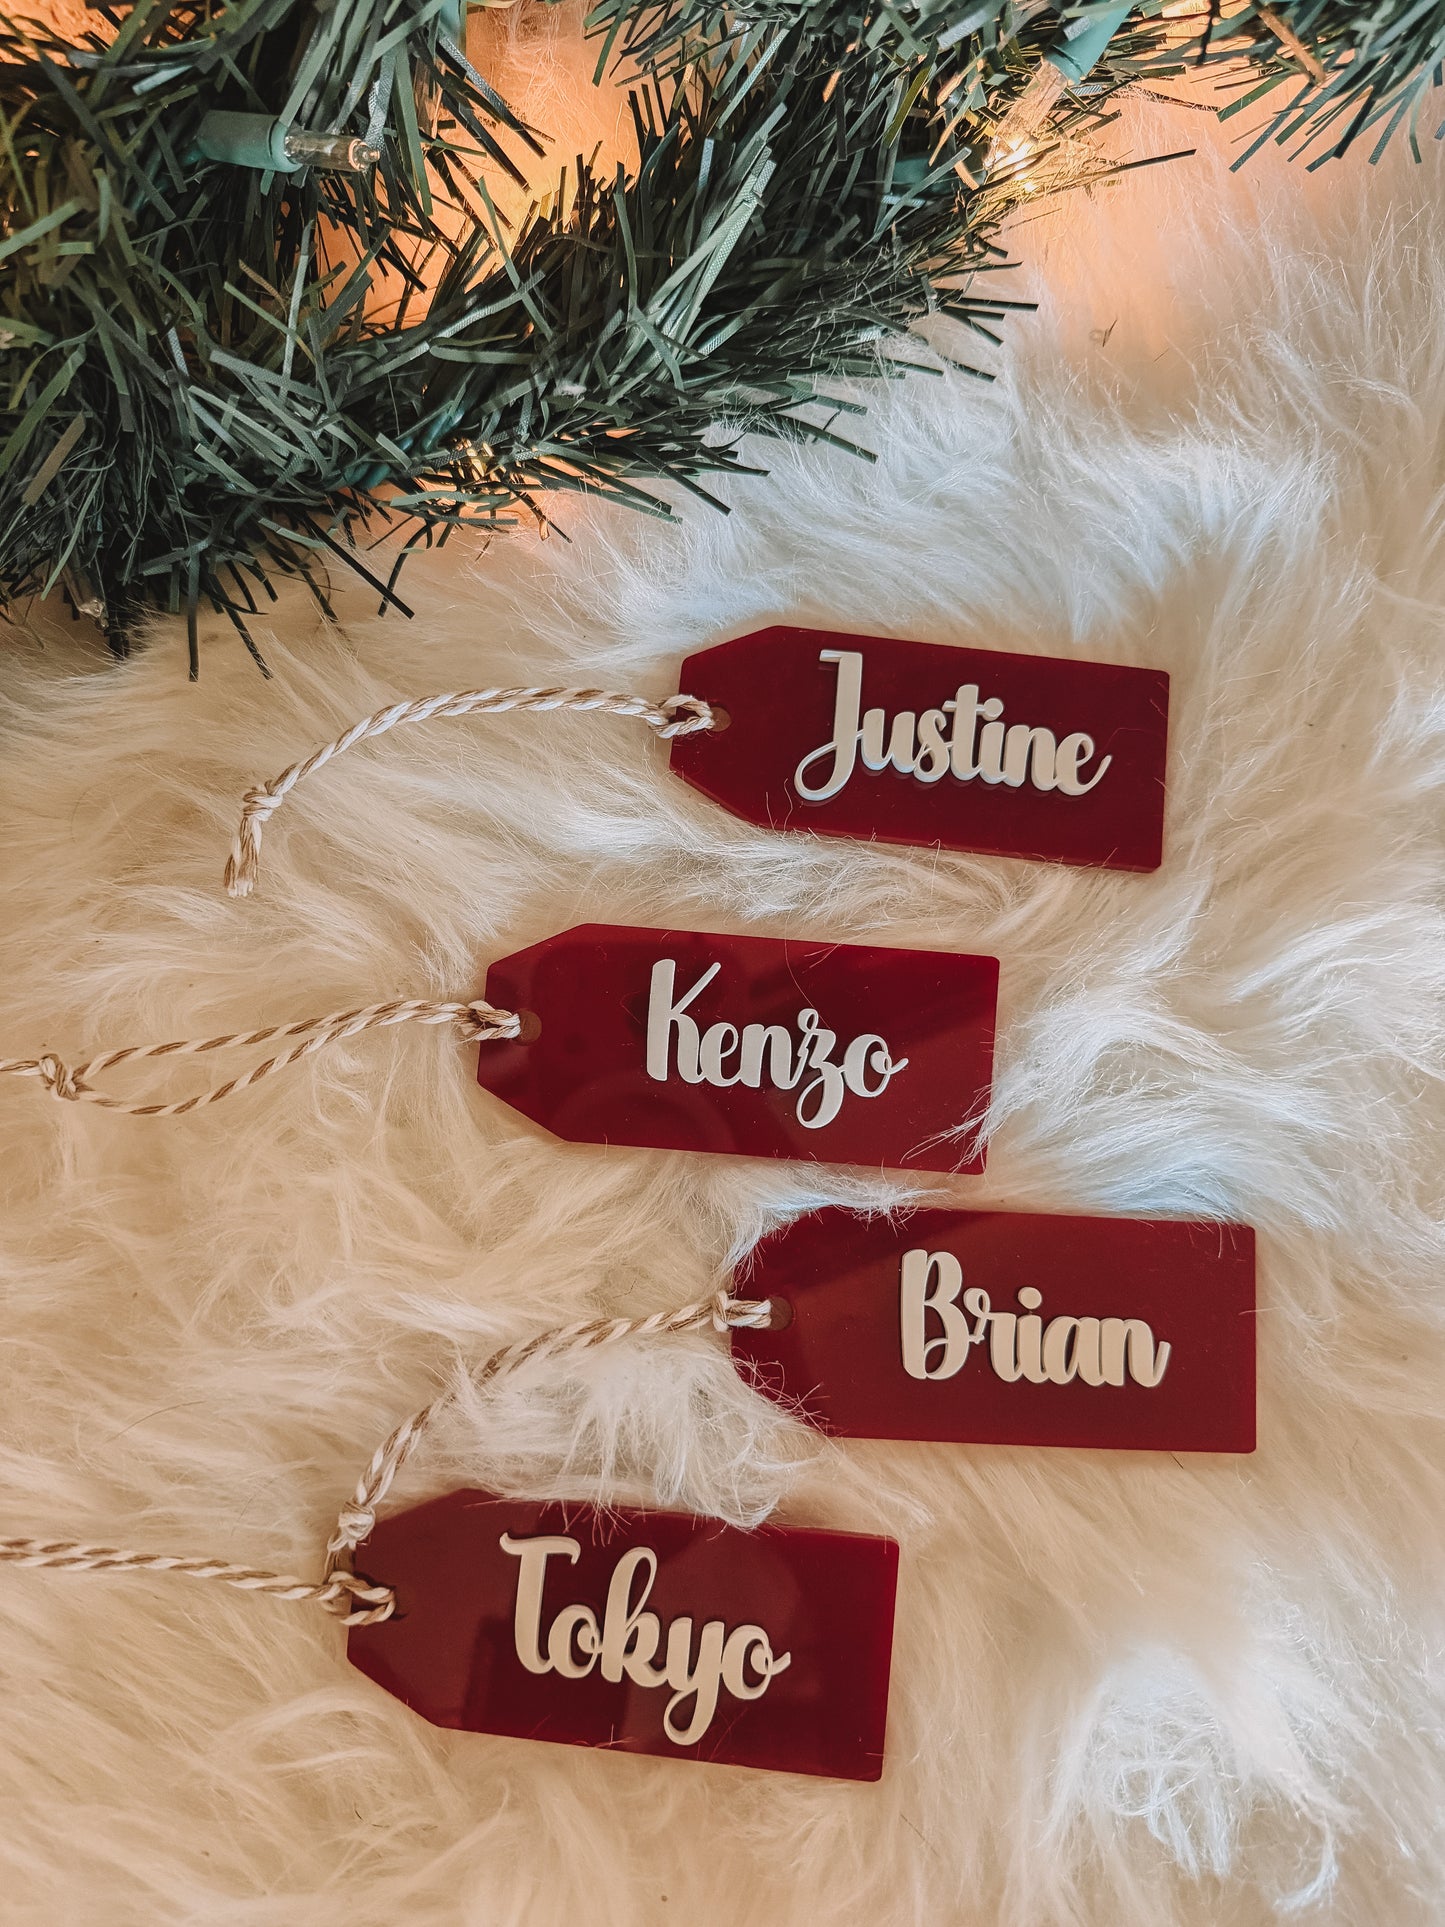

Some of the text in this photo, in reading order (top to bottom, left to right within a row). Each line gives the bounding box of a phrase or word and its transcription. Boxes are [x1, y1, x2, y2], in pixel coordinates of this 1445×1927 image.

[794, 649, 1112, 802] Justine
[646, 958, 909, 1130] Kenzo
[900, 1249, 1172, 1389] Brian
[499, 1532, 792, 1746] Tokyo
